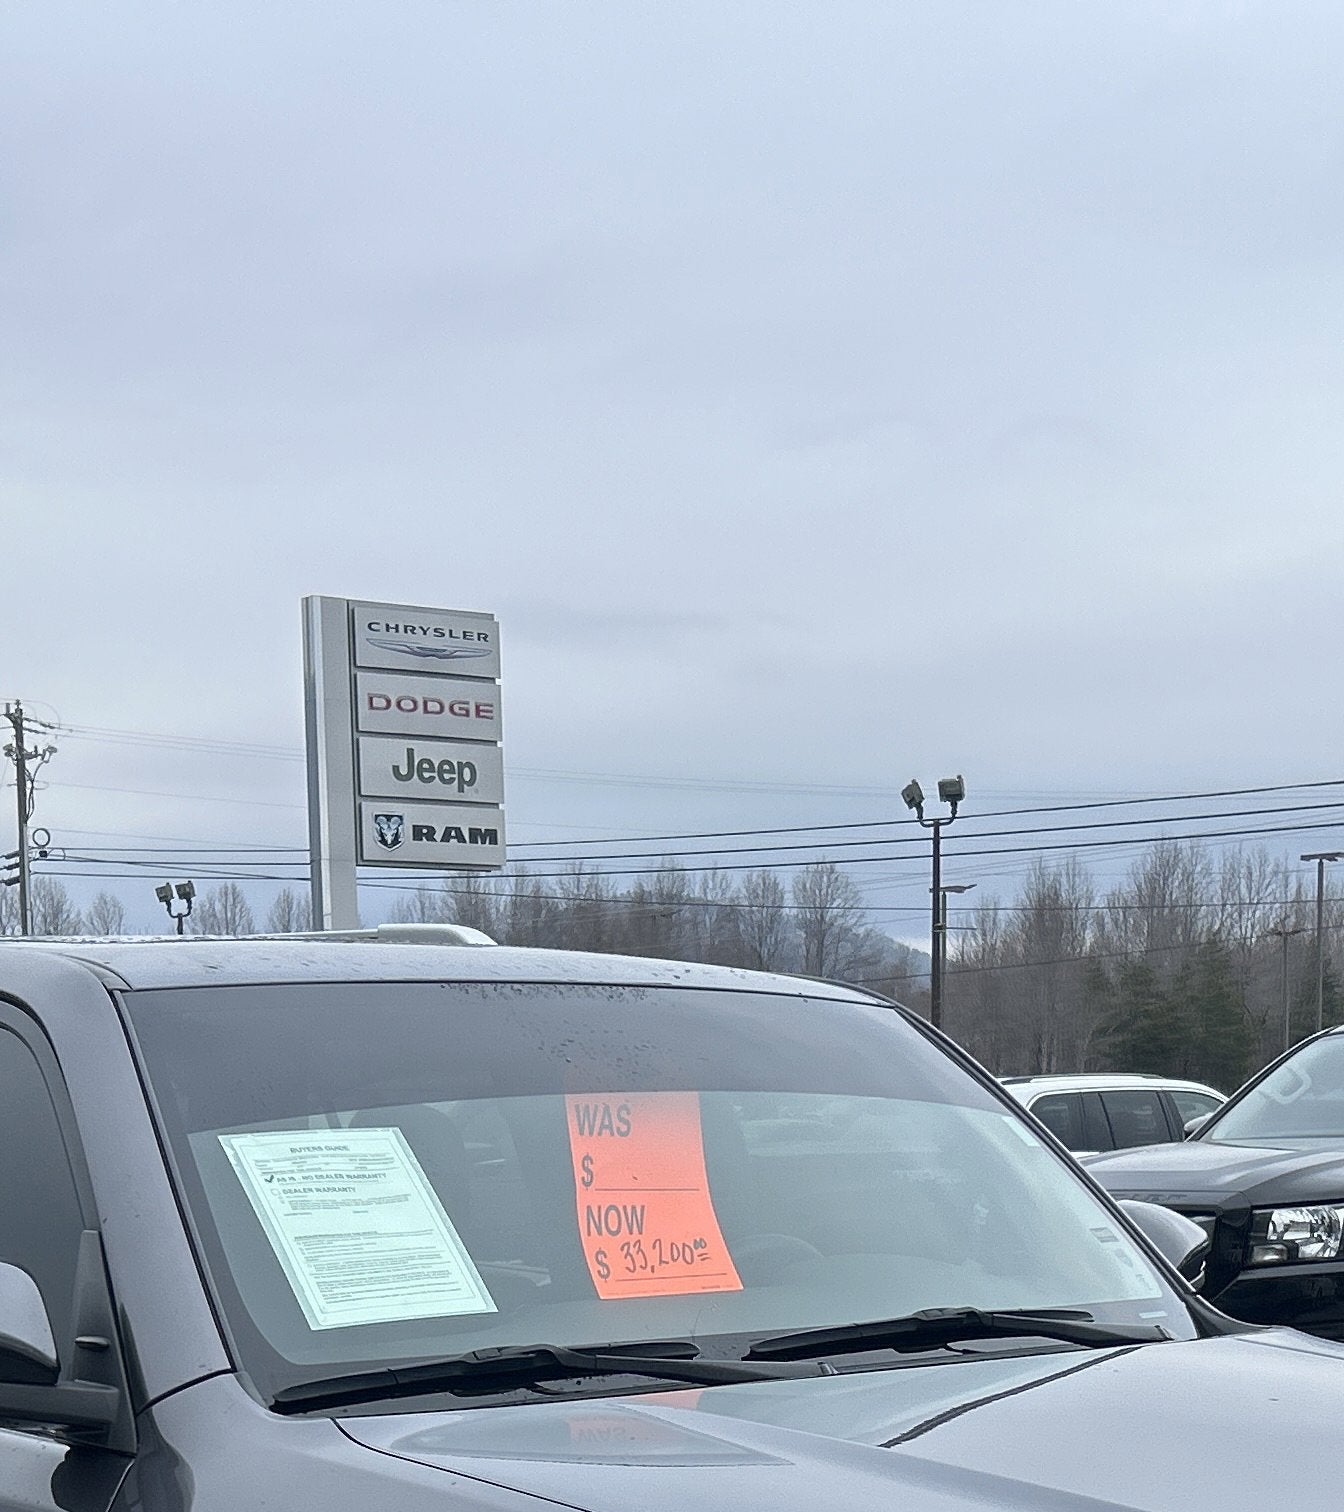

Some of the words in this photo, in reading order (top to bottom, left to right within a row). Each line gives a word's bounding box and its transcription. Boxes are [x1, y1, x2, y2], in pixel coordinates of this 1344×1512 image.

[367, 621, 489, 642] CHRYSLER
[368, 693, 494, 720] DODGE
[392, 747, 478, 793] Jeep
[412, 824, 499, 846] RAM
[574, 1103, 633, 1138] WAS
[581, 1152, 594, 1191] $
[586, 1204, 646, 1237] NOW
[595, 1247, 611, 1284] $
